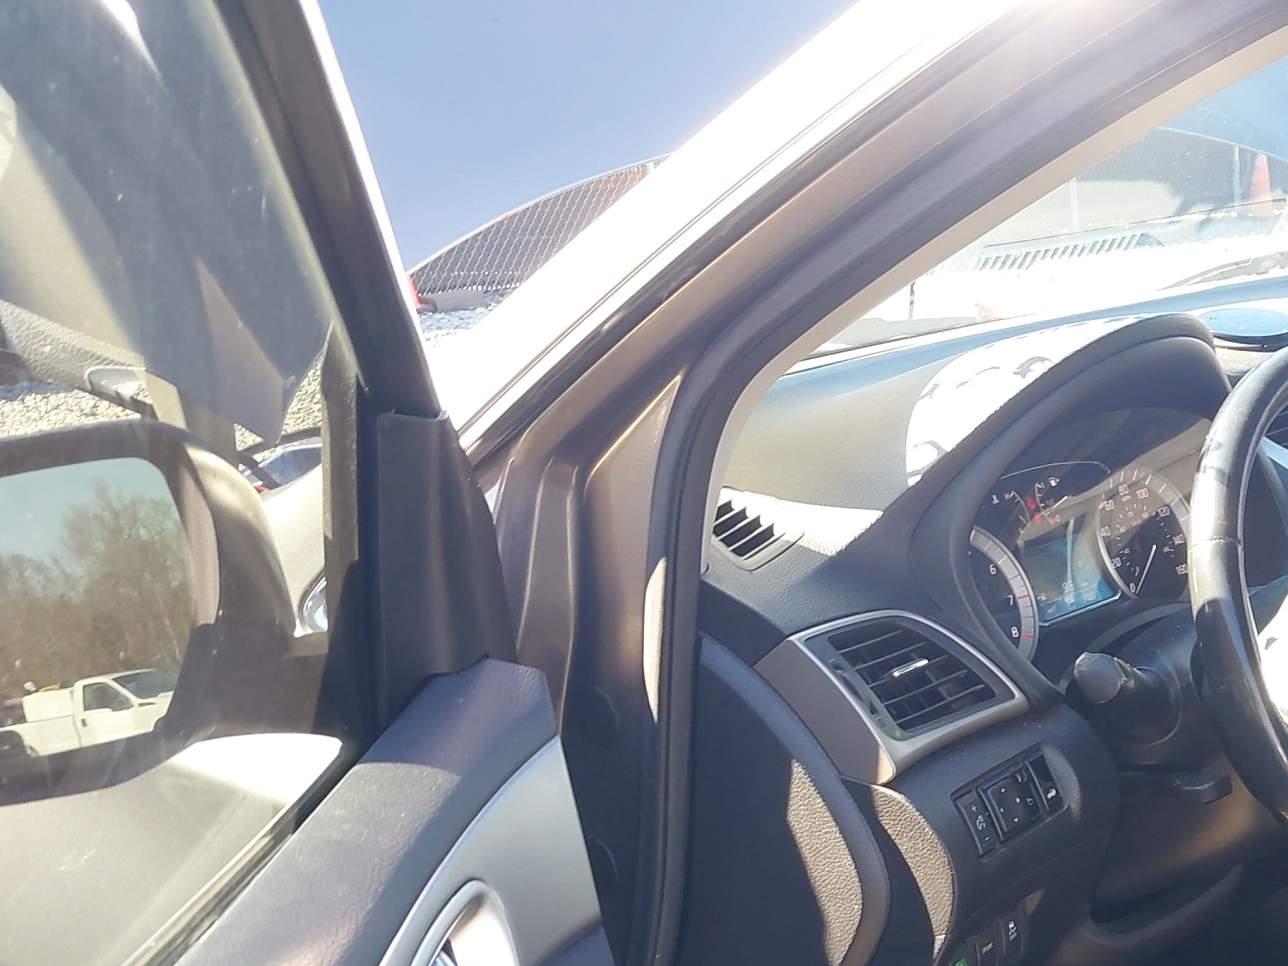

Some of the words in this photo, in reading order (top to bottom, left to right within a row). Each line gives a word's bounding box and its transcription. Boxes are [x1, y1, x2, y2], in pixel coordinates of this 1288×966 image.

[989, 564, 997, 575] 6
[1129, 582, 1136, 593] 0
[1008, 595, 1014, 606] 7
[1010, 626, 1019, 638] 8
